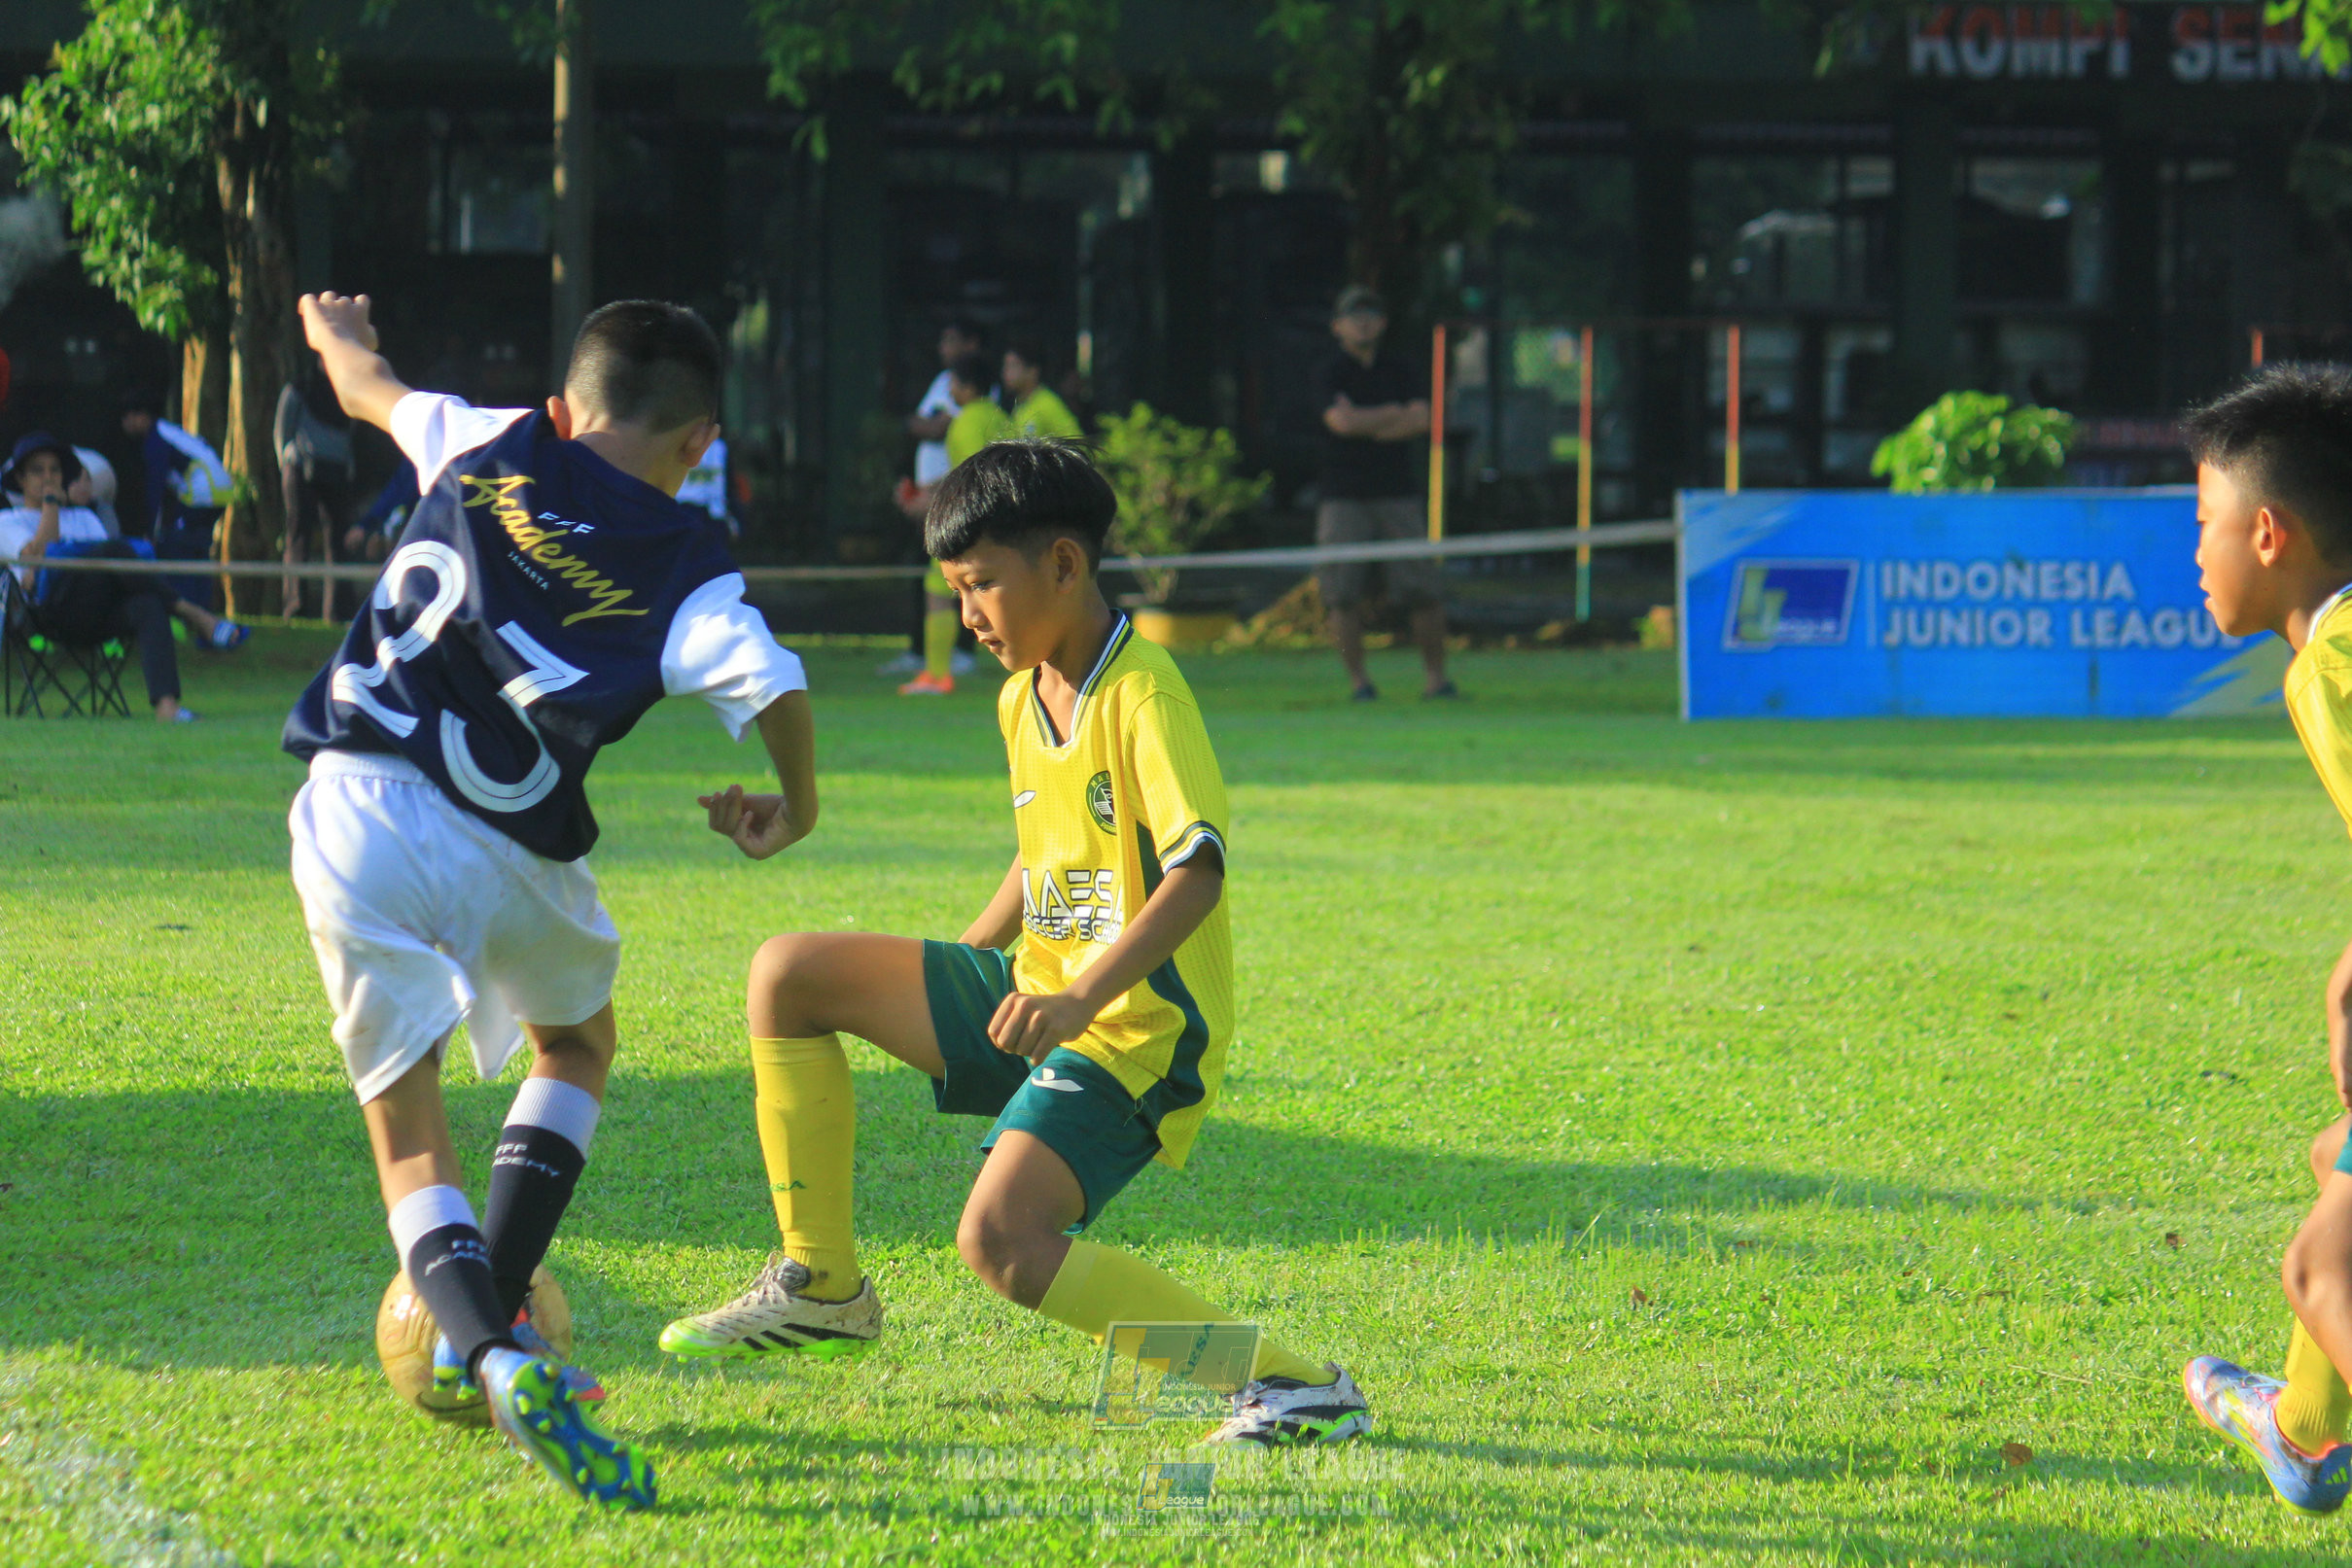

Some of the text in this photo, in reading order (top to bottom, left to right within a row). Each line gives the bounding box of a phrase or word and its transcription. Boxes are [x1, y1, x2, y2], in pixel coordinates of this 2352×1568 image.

[1908, 6, 2352, 82] KOMPI SEN
[537, 511, 595, 534] FFF
[458, 473, 649, 627] Academy
[508, 550, 549, 591] JAKARTA
[1881, 560, 2135, 602] INDONESIA
[1882, 607, 2054, 648] JUNIOR
[332, 540, 590, 813] 23
